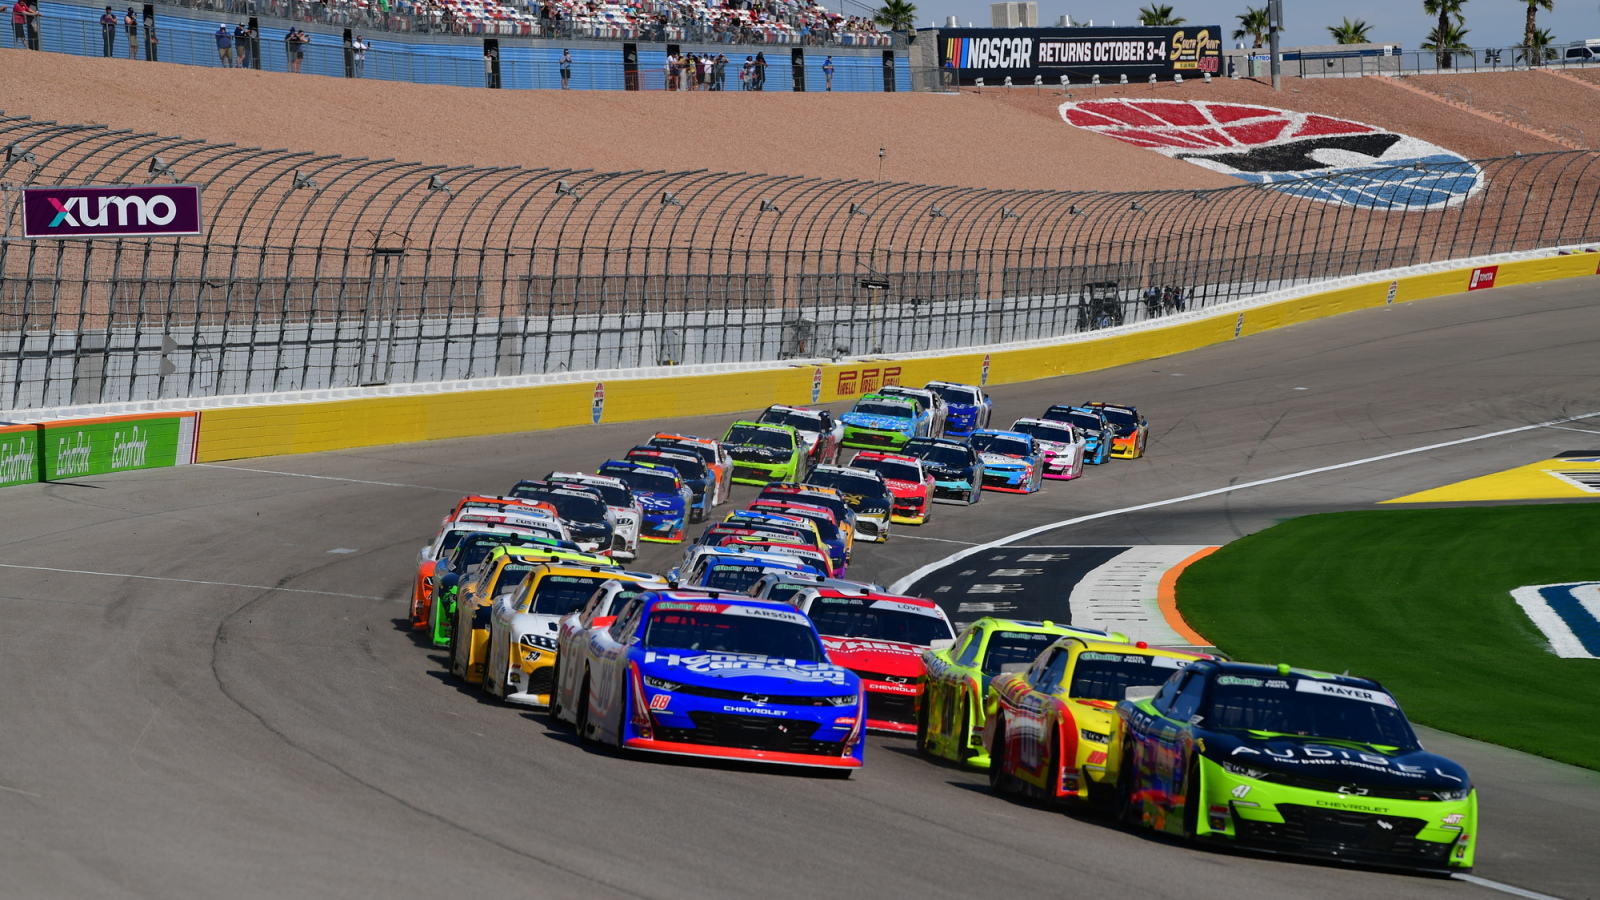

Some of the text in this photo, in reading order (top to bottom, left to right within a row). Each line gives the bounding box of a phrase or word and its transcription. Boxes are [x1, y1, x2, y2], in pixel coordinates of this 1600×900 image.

[967, 37, 1031, 69] NASCAR
[1038, 42, 1166, 62] RETURNS OCTOBER 3-4
[1198, 57, 1218, 72] 400
[47, 194, 177, 227] xumo
[1479, 272, 1494, 282] TOYOTA
[837, 371, 858, 395] PIRELLI
[860, 368, 880, 393] PIRELLI
[56, 431, 92, 476] EchoPark
[111, 426, 148, 469] EchoPark
[0, 436, 35, 483] EchoPark
[515, 519, 548, 527] CUSTER
[786, 549, 818, 557] BURTON
[745, 608, 797, 621] LARSON
[897, 603, 923, 612] LOVE
[525, 650, 542, 662] 54
[869, 683, 917, 693] CHEVROLE
[1321, 685, 1374, 700] MAYER
[650, 694, 671, 710] 88
[723, 705, 788, 716] CHEVROLET
[1231, 746, 1462, 783] AUDIBEL
[1273, 756, 1300, 764] Hear
[1340, 759, 1387, 773] Connect
[1231, 785, 1252, 799] 41
[1316, 800, 1390, 813] CHEVROLET
